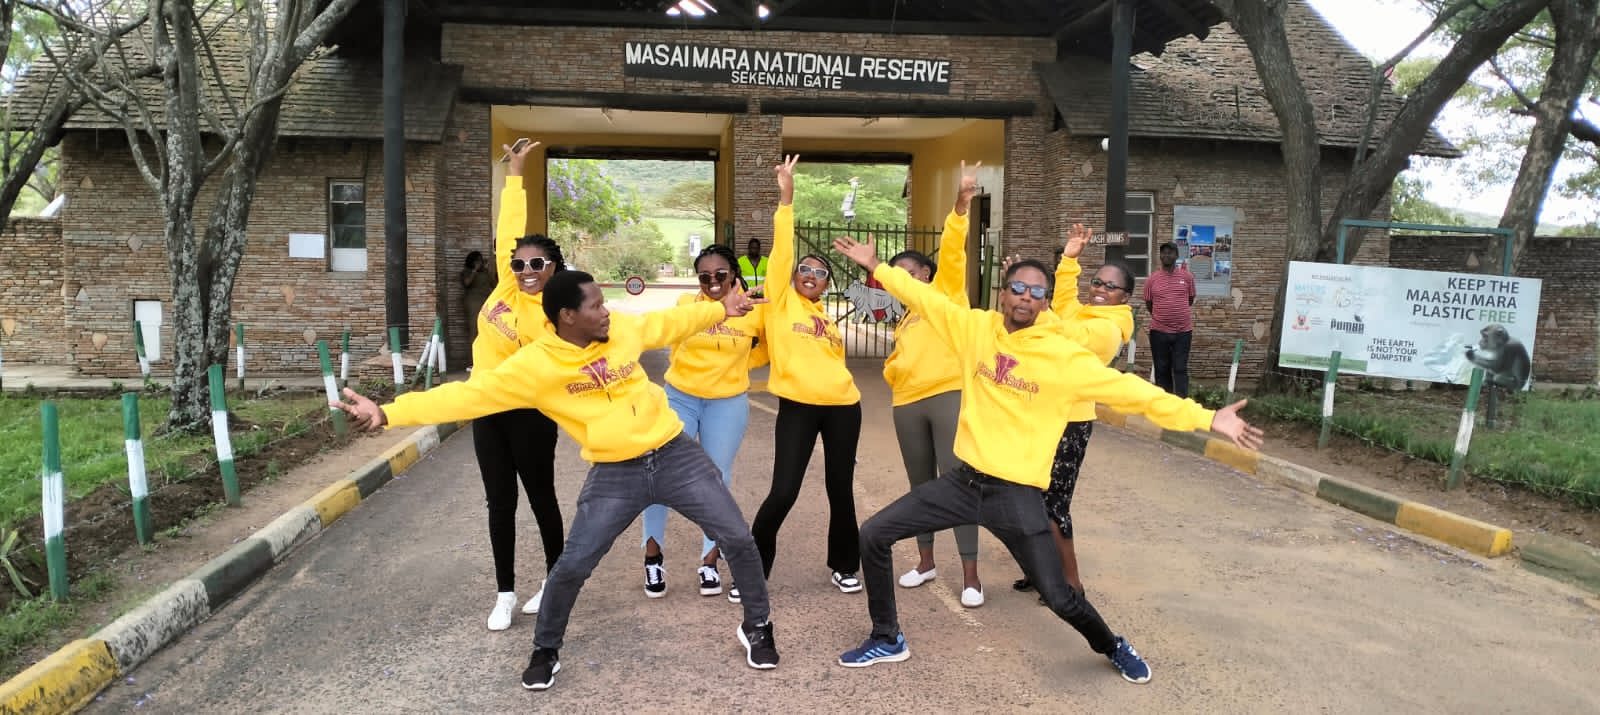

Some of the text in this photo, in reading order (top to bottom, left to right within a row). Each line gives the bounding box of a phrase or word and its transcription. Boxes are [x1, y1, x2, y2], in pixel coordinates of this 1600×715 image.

[625, 42, 949, 83] MASAI MARA NATIONAL RESERVE
[731, 71, 842, 89] SEKENANI GATE
[1447, 277, 1520, 294] KEEP THE
[1406, 289, 1468, 305] MAASAI
[1471, 294, 1517, 309] MARA
[1412, 304, 1516, 324] PLASTIC FREE
[1372, 337, 1415, 348] THE EARTH
[1370, 352, 1413, 363] DUMPSTER
[1395, 347, 1418, 356] YOUR
